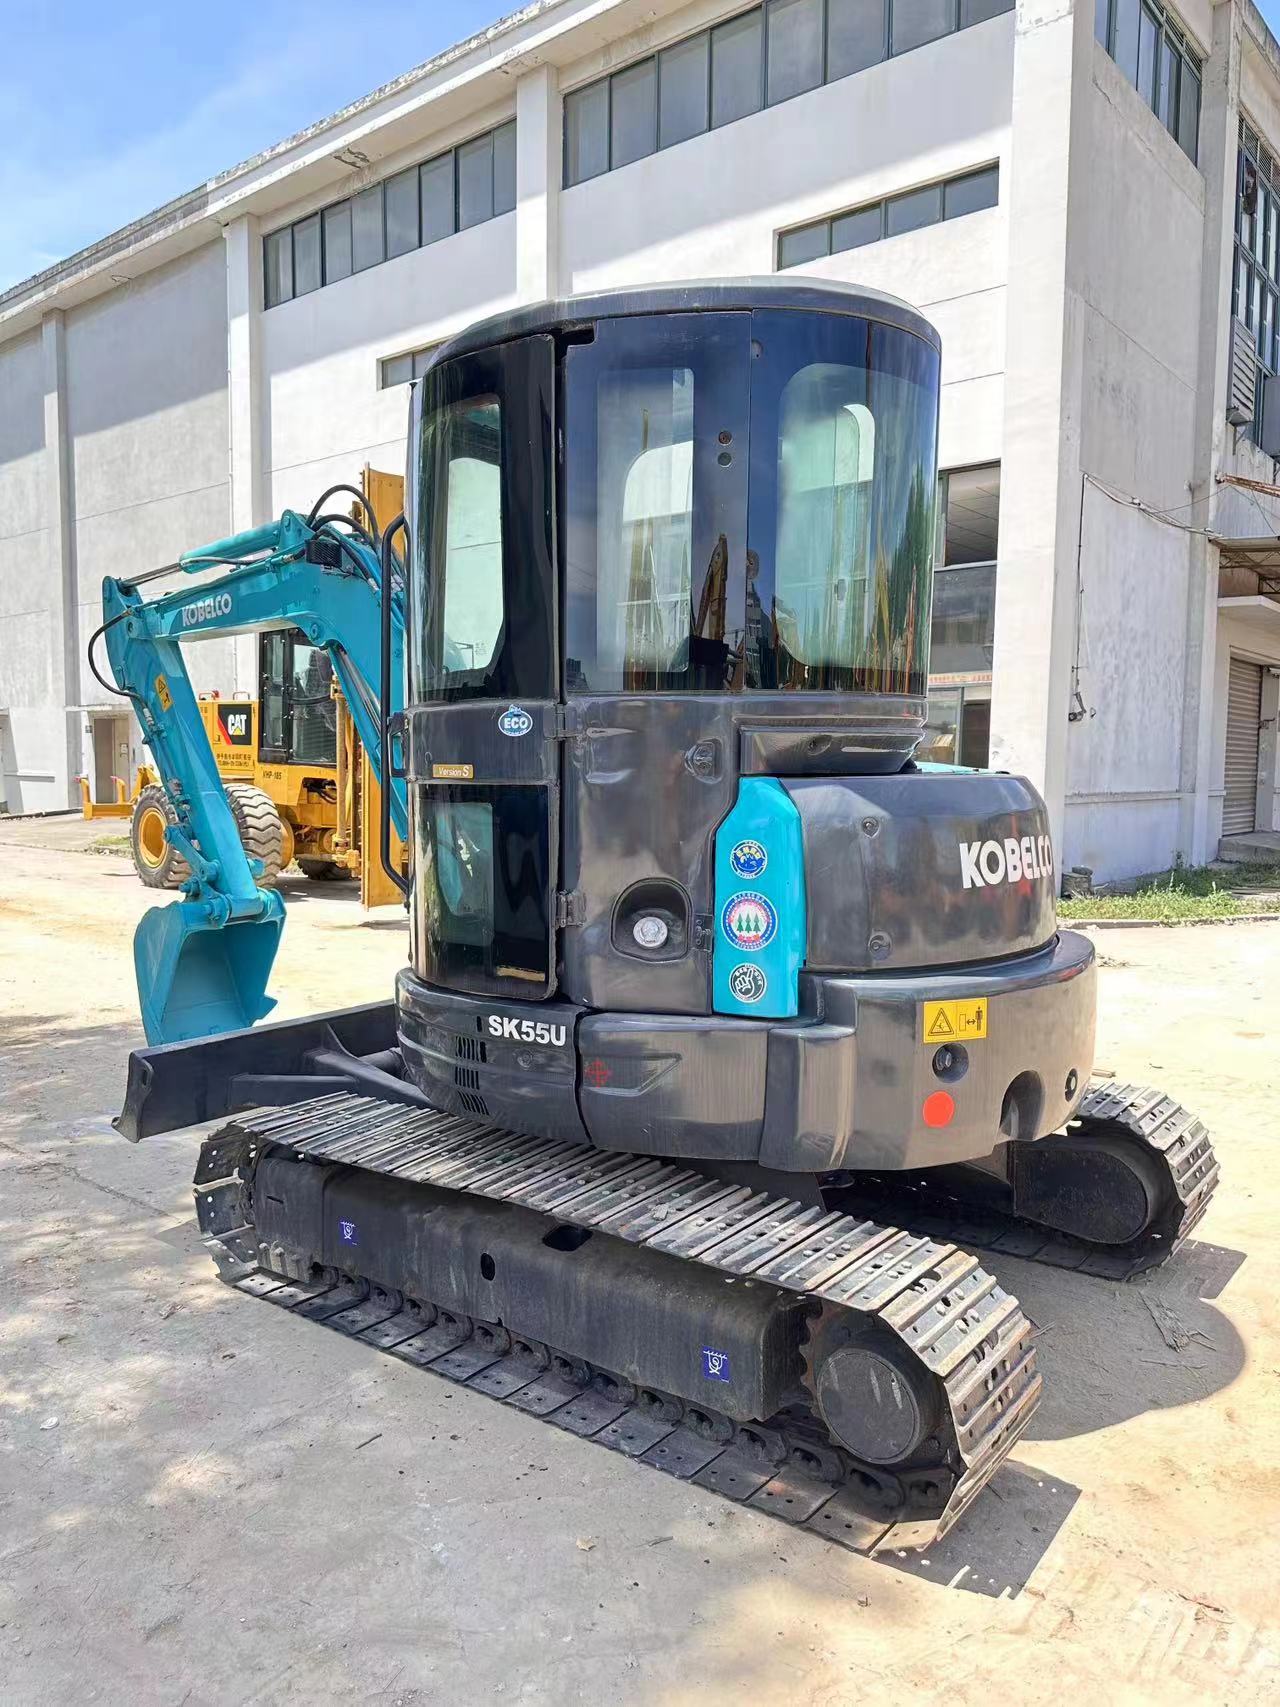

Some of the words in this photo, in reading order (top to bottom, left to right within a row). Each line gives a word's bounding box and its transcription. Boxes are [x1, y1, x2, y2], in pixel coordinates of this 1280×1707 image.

[182, 593, 232, 627] KOBELCO
[228, 714, 247, 735] CAT
[504, 718, 528, 729] ECO
[439, 767, 462, 776] Version
[462, 765, 470, 777] S
[959, 835, 1053, 888] KOBELCO
[488, 1015, 566, 1046] SK55U
